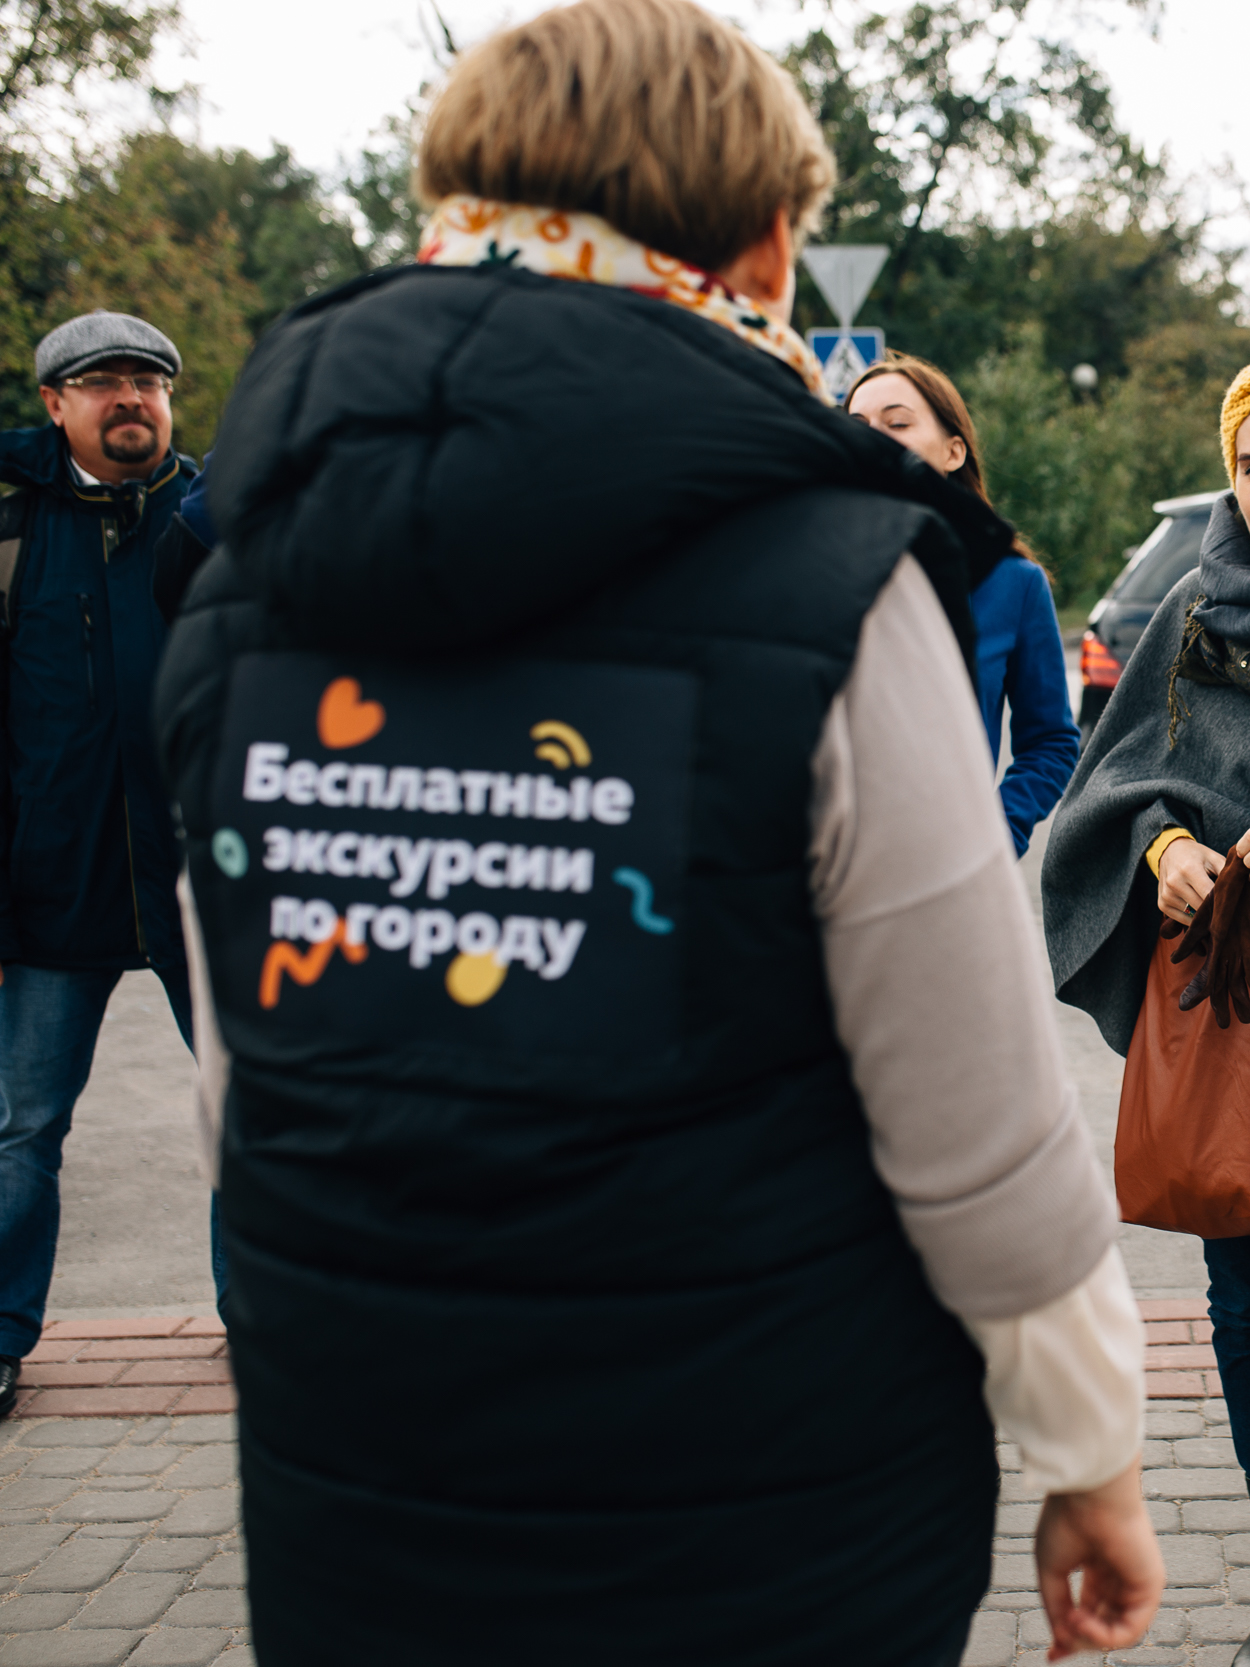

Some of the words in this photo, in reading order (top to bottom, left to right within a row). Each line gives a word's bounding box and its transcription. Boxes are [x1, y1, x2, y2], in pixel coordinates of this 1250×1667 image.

[243, 742, 634, 824] Бесплатные
[263, 827, 594, 900] экскурсии
[270, 896, 337, 943] по
[344, 903, 586, 980] городу
